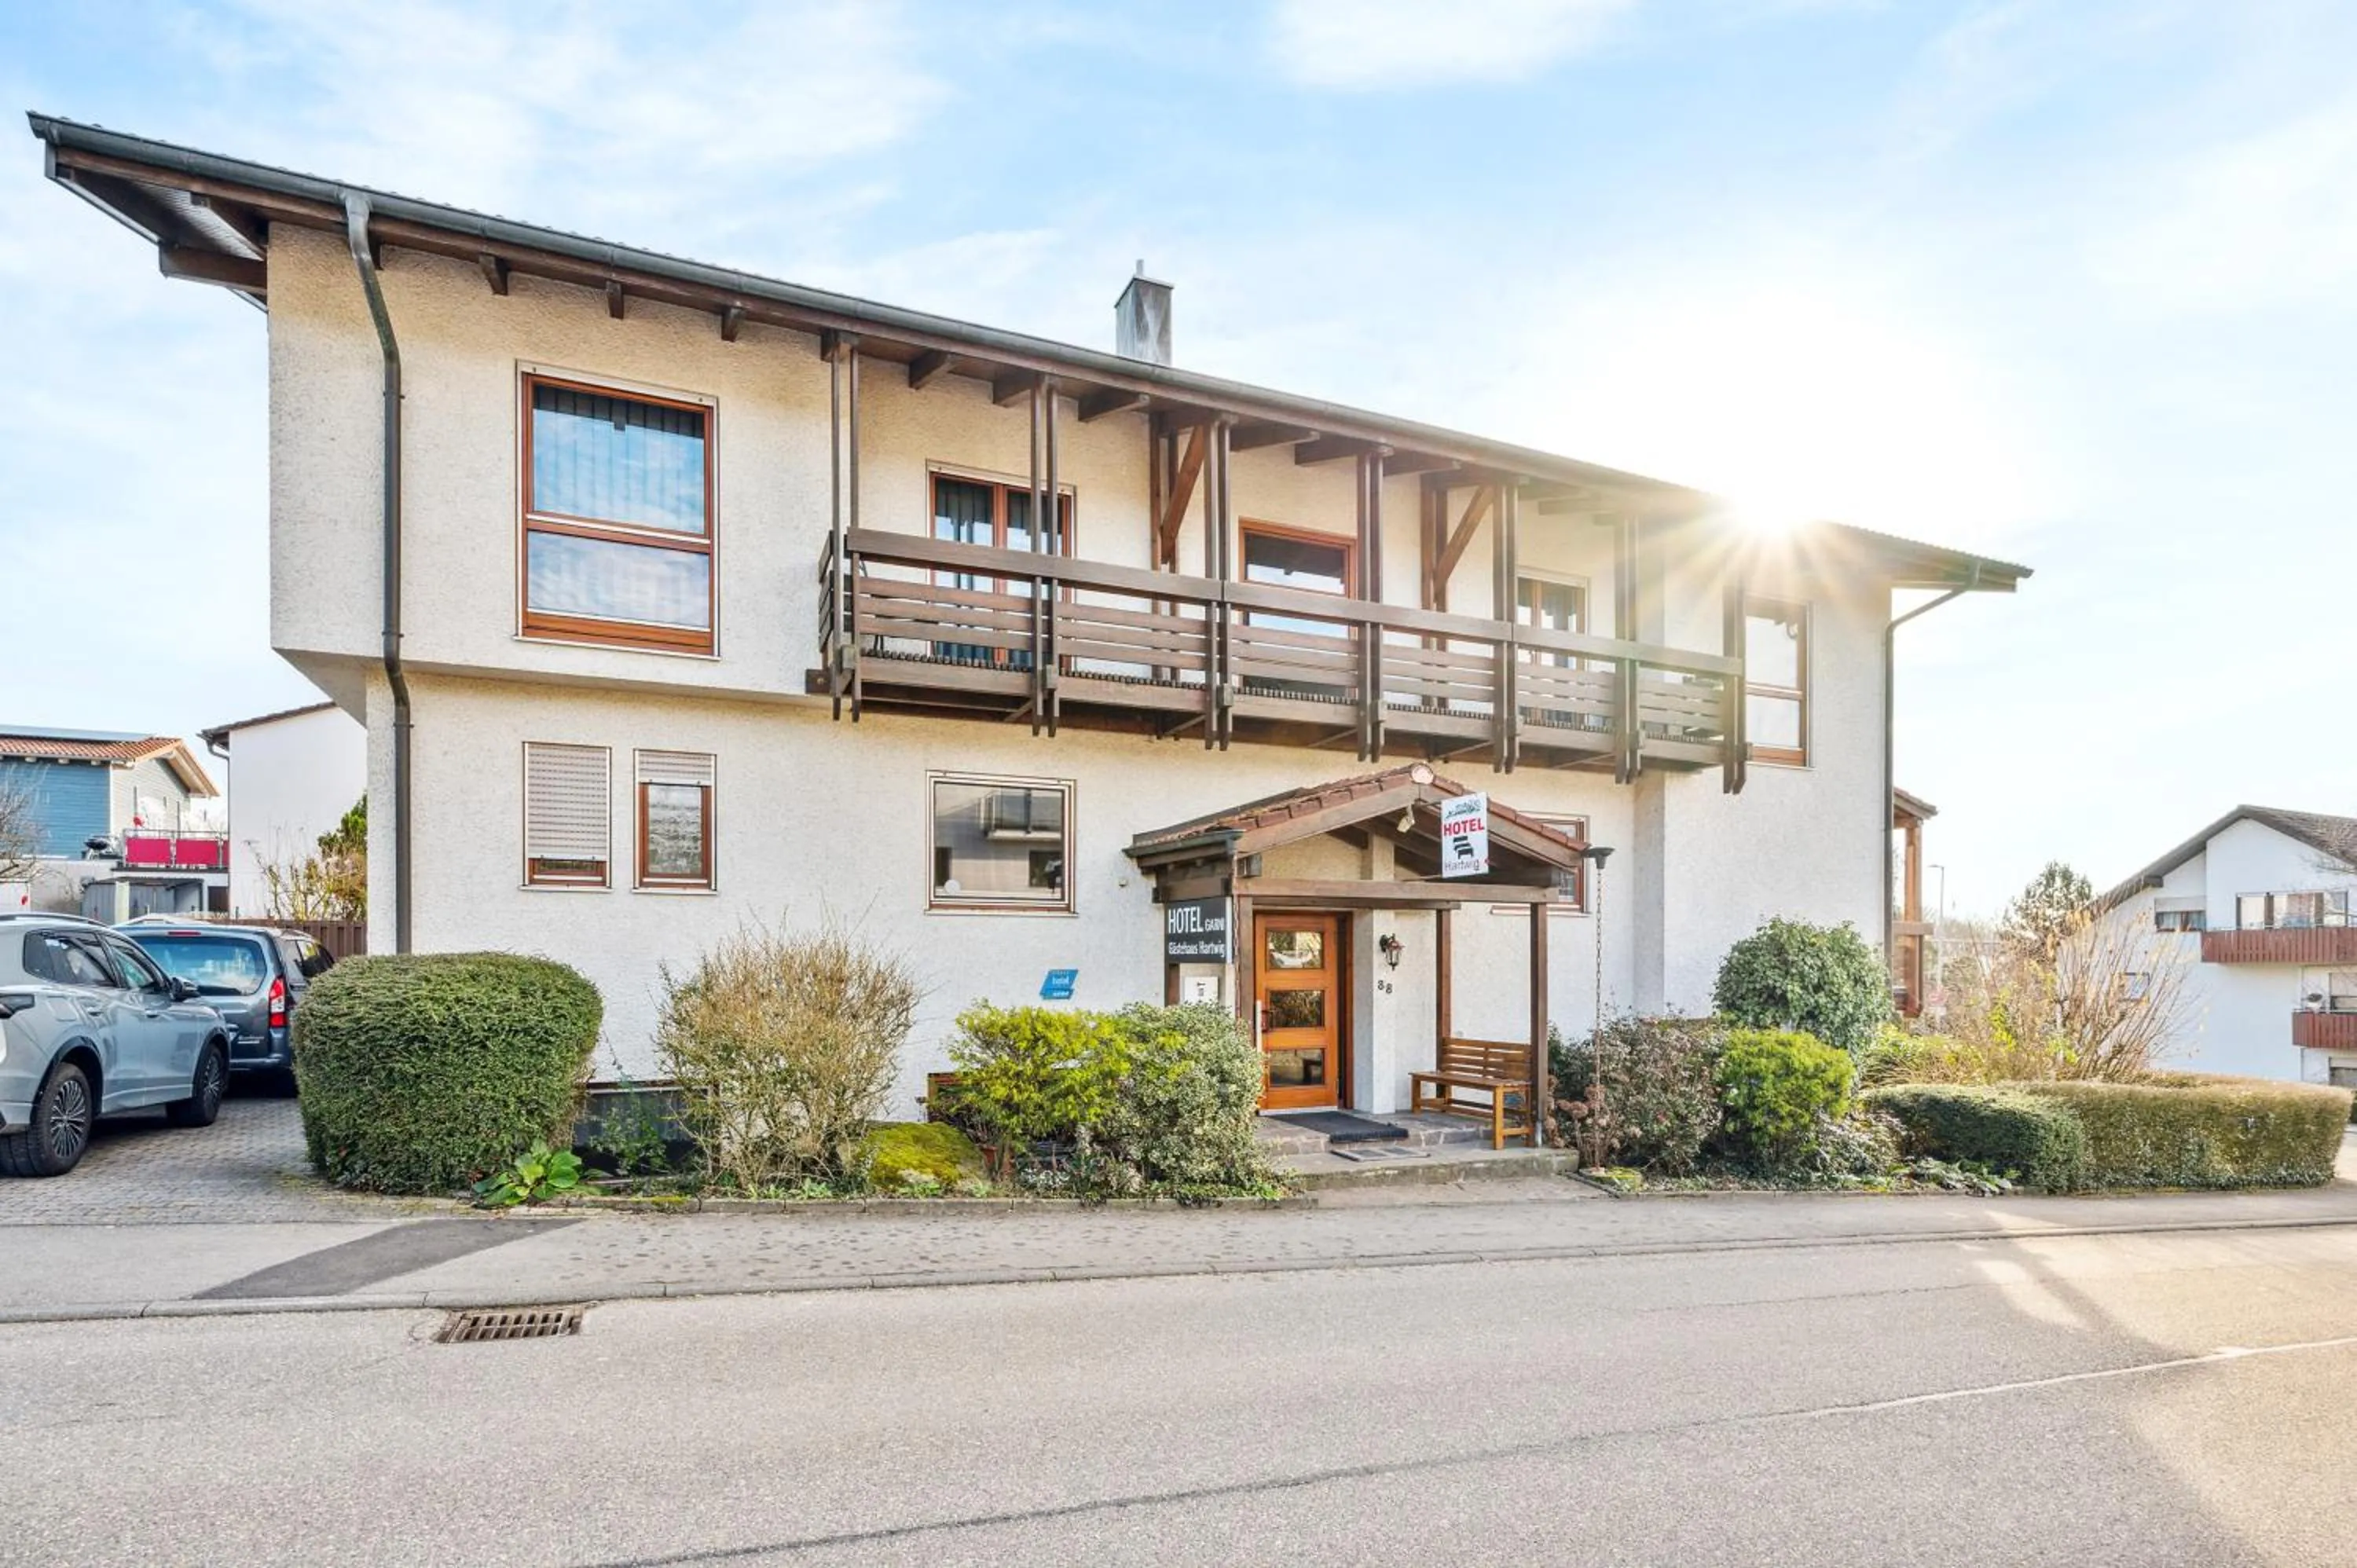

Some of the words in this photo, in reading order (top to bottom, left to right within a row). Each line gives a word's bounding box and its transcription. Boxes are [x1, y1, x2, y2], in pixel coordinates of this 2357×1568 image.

[1443, 818, 1485, 836] HOTEL
[1168, 906, 1204, 934] HOTEL
[1204, 918, 1225, 932] GARNI
[1199, 940, 1225, 958] Hartwig
